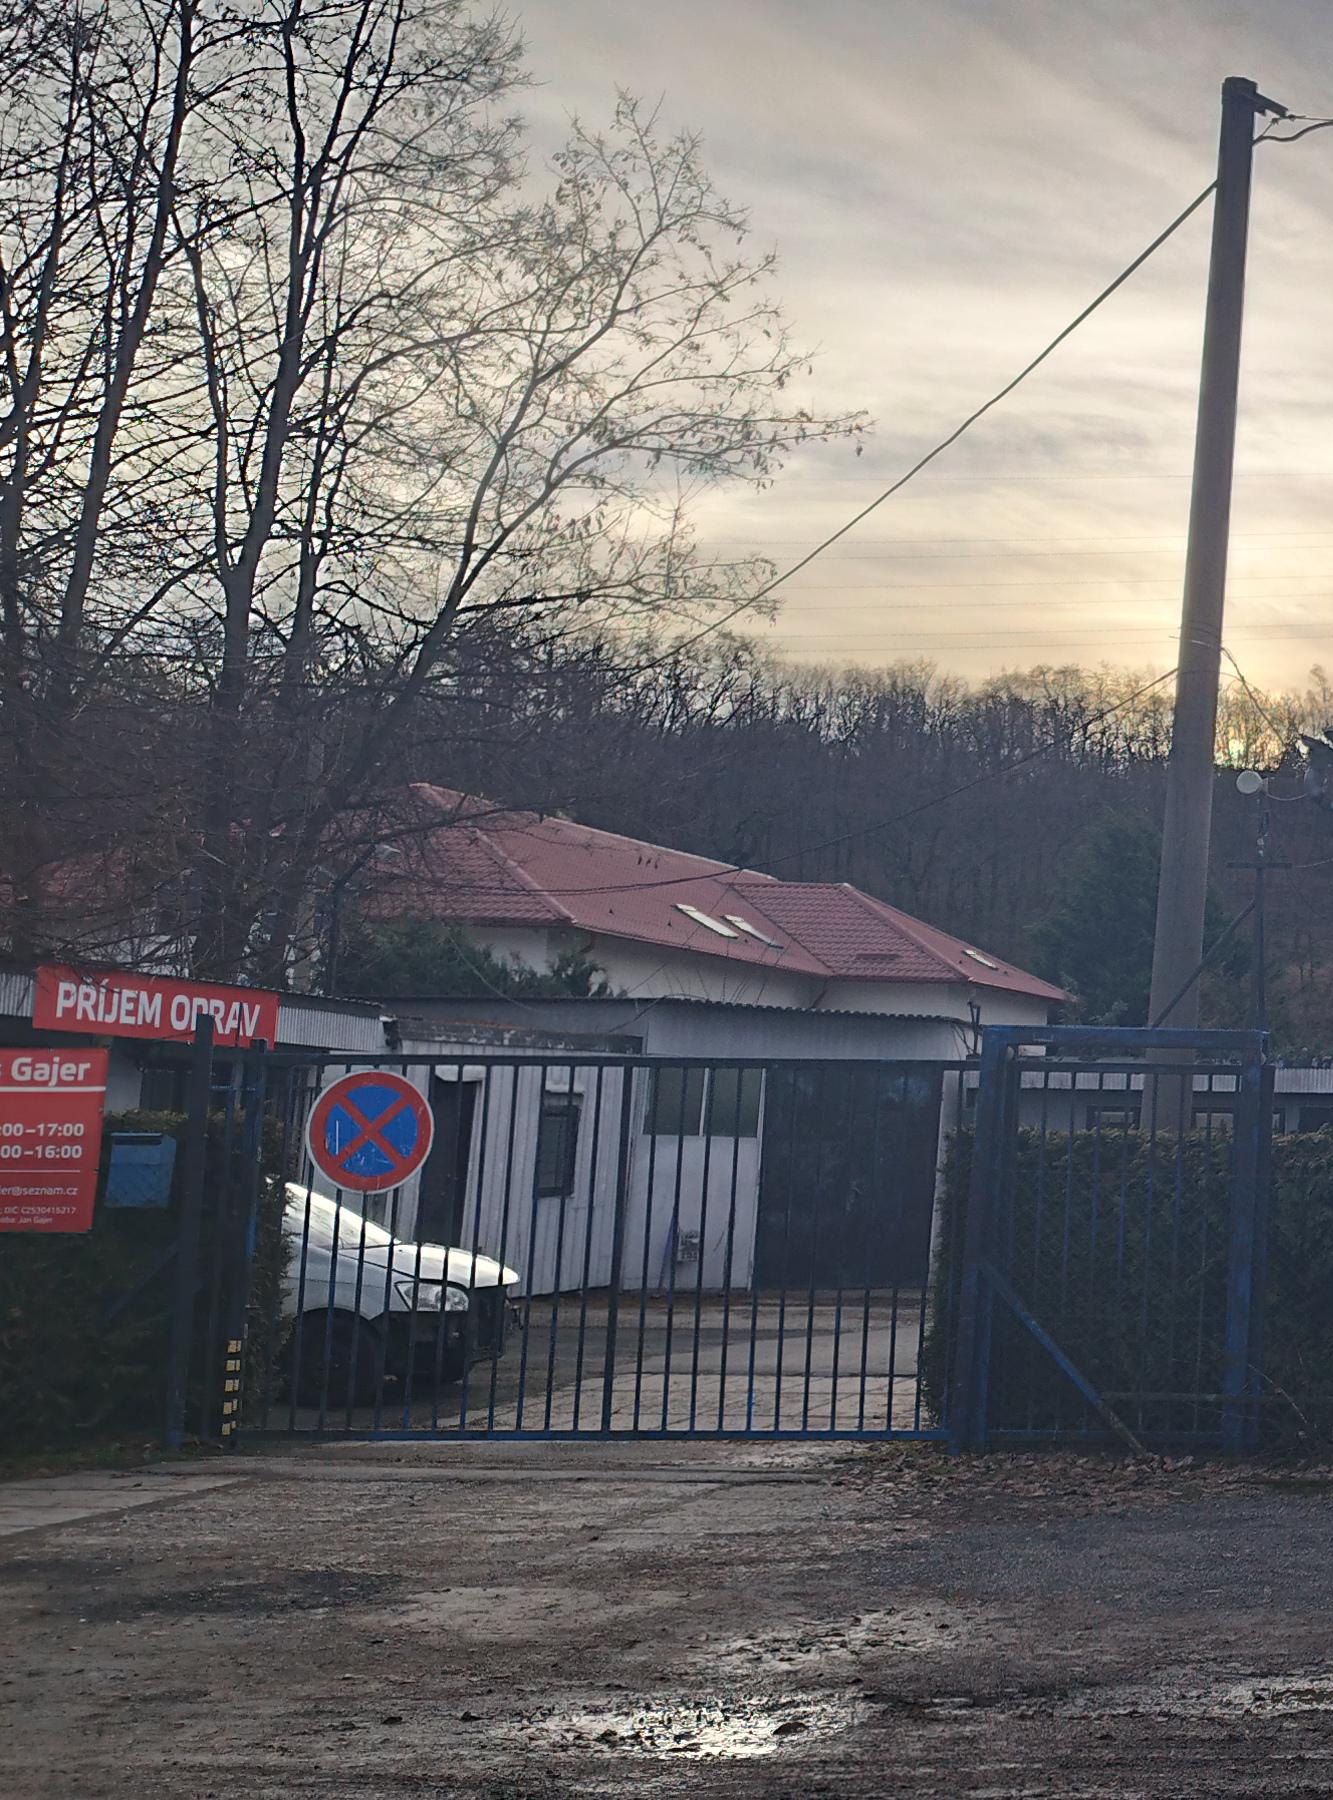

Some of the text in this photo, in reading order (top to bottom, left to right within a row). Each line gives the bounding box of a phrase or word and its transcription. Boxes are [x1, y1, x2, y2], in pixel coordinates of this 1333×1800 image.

[55, 975, 261, 1038] PŘÍJEM OPRAV
[11, 1056, 91, 1088] Gajer
